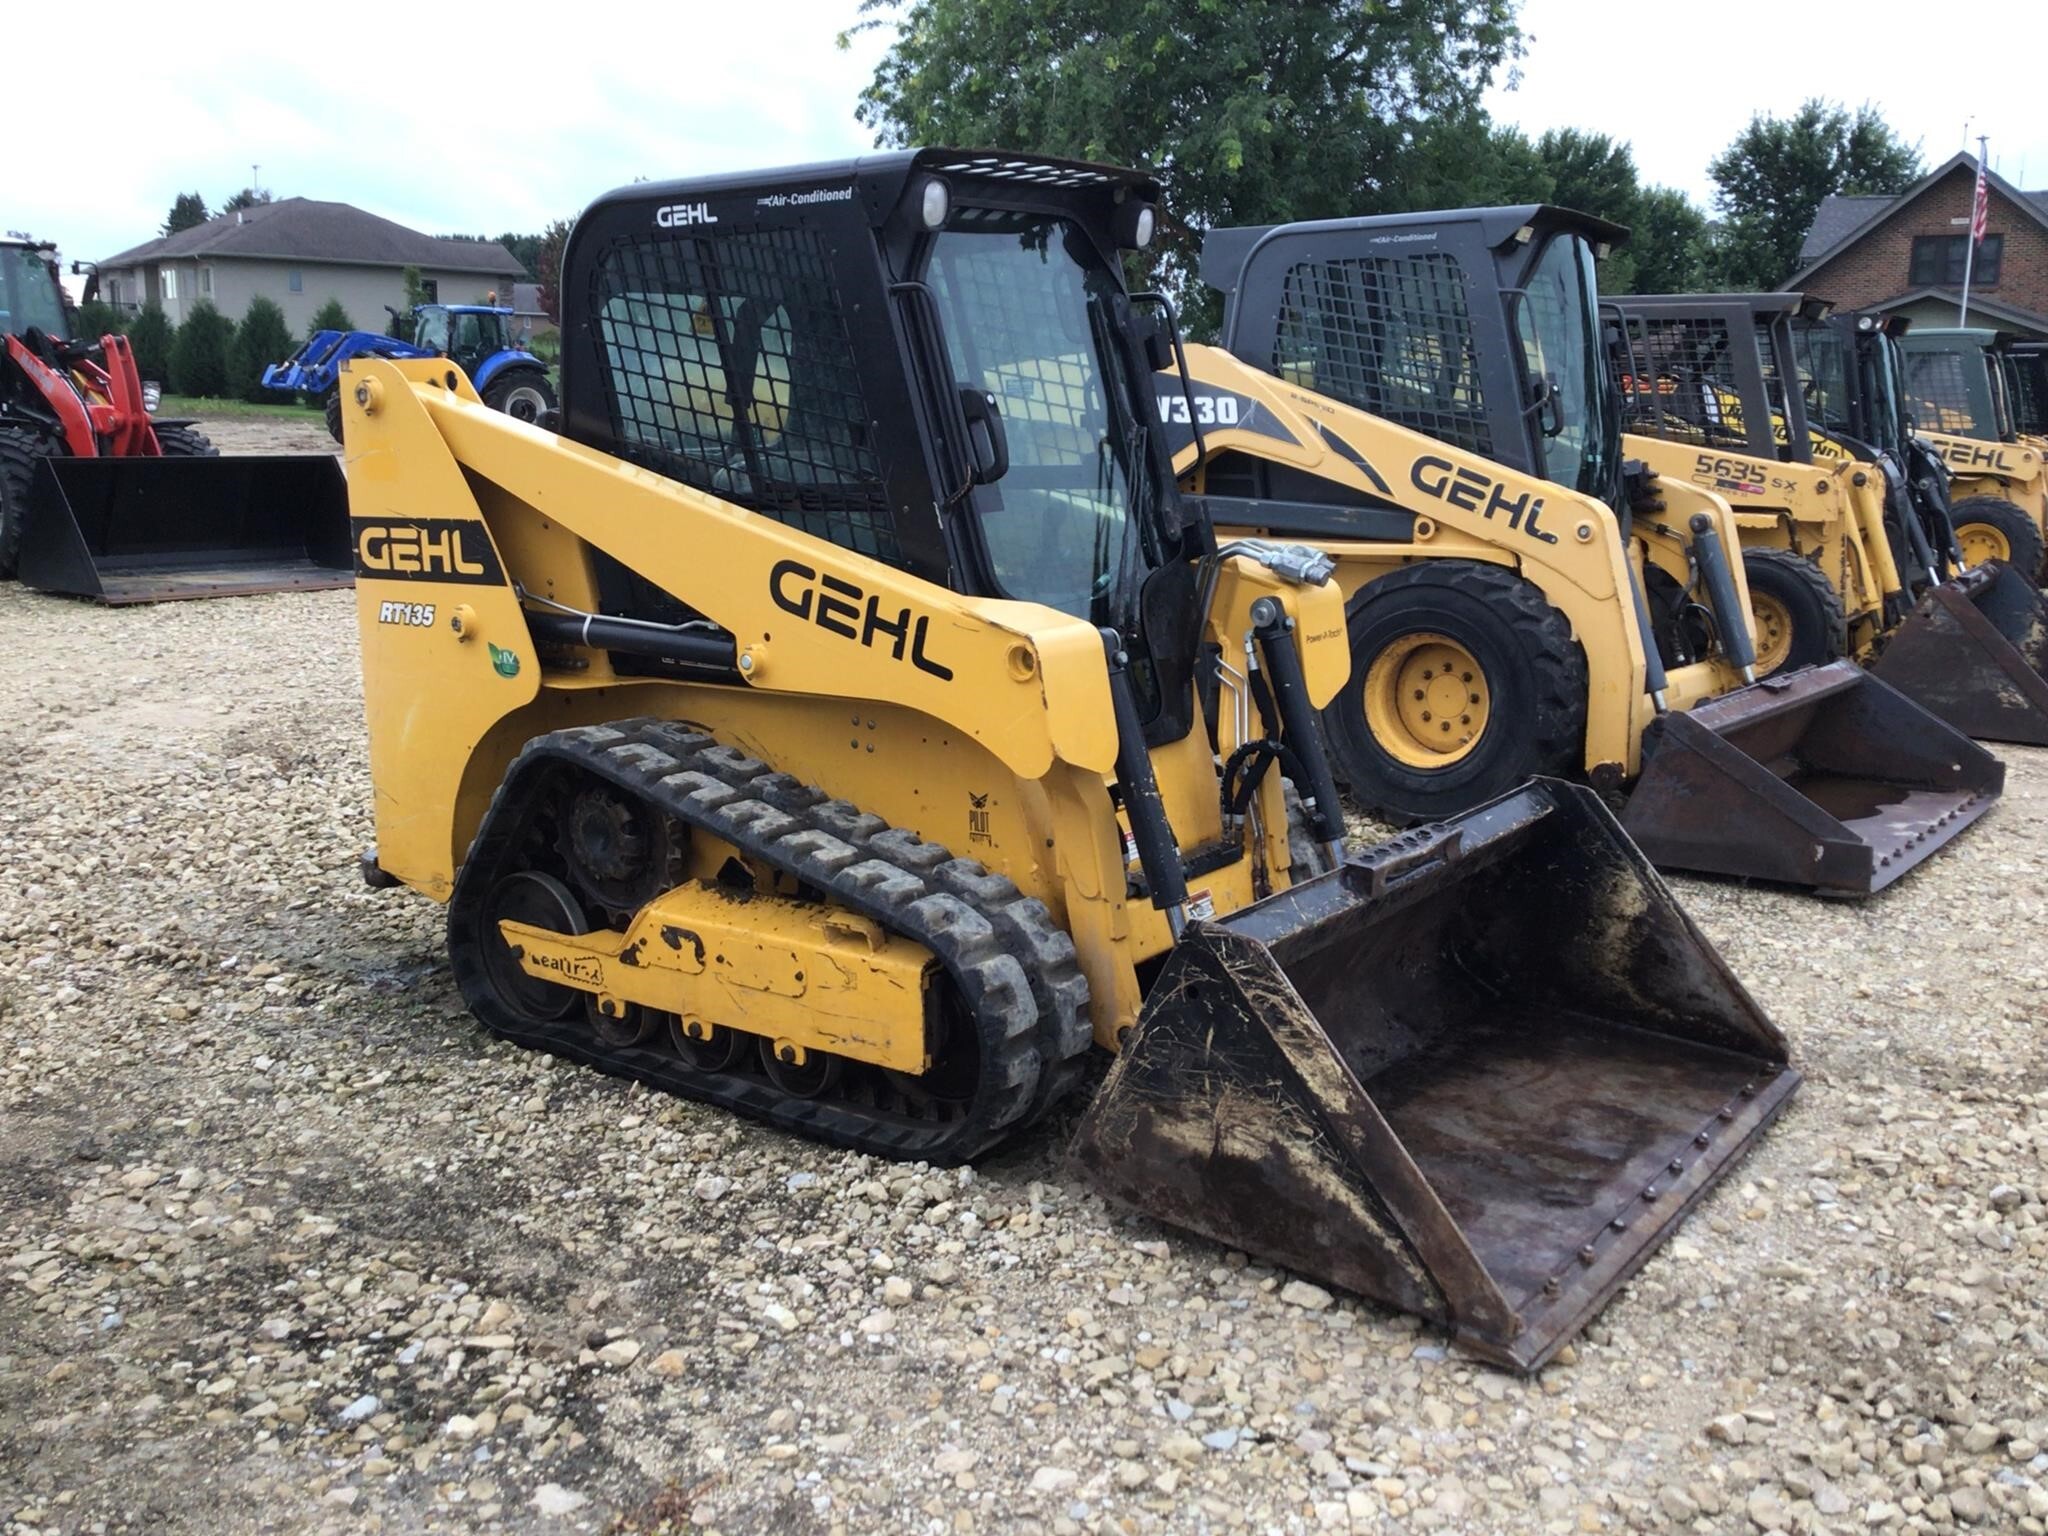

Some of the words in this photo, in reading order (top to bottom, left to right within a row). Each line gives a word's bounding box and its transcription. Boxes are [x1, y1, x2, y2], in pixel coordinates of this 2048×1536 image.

[771, 186, 853, 207] Air-Conditioned
[656, 203, 718, 228] GEHL
[1156, 395, 1239, 424] V330
[1695, 454, 1768, 484] 5635
[1771, 478, 1798, 491] SX
[1410, 455, 1559, 545] GEHL
[359, 526, 485, 576] GEHL
[379, 601, 436, 628] RT135
[769, 559, 954, 682] GEHL
